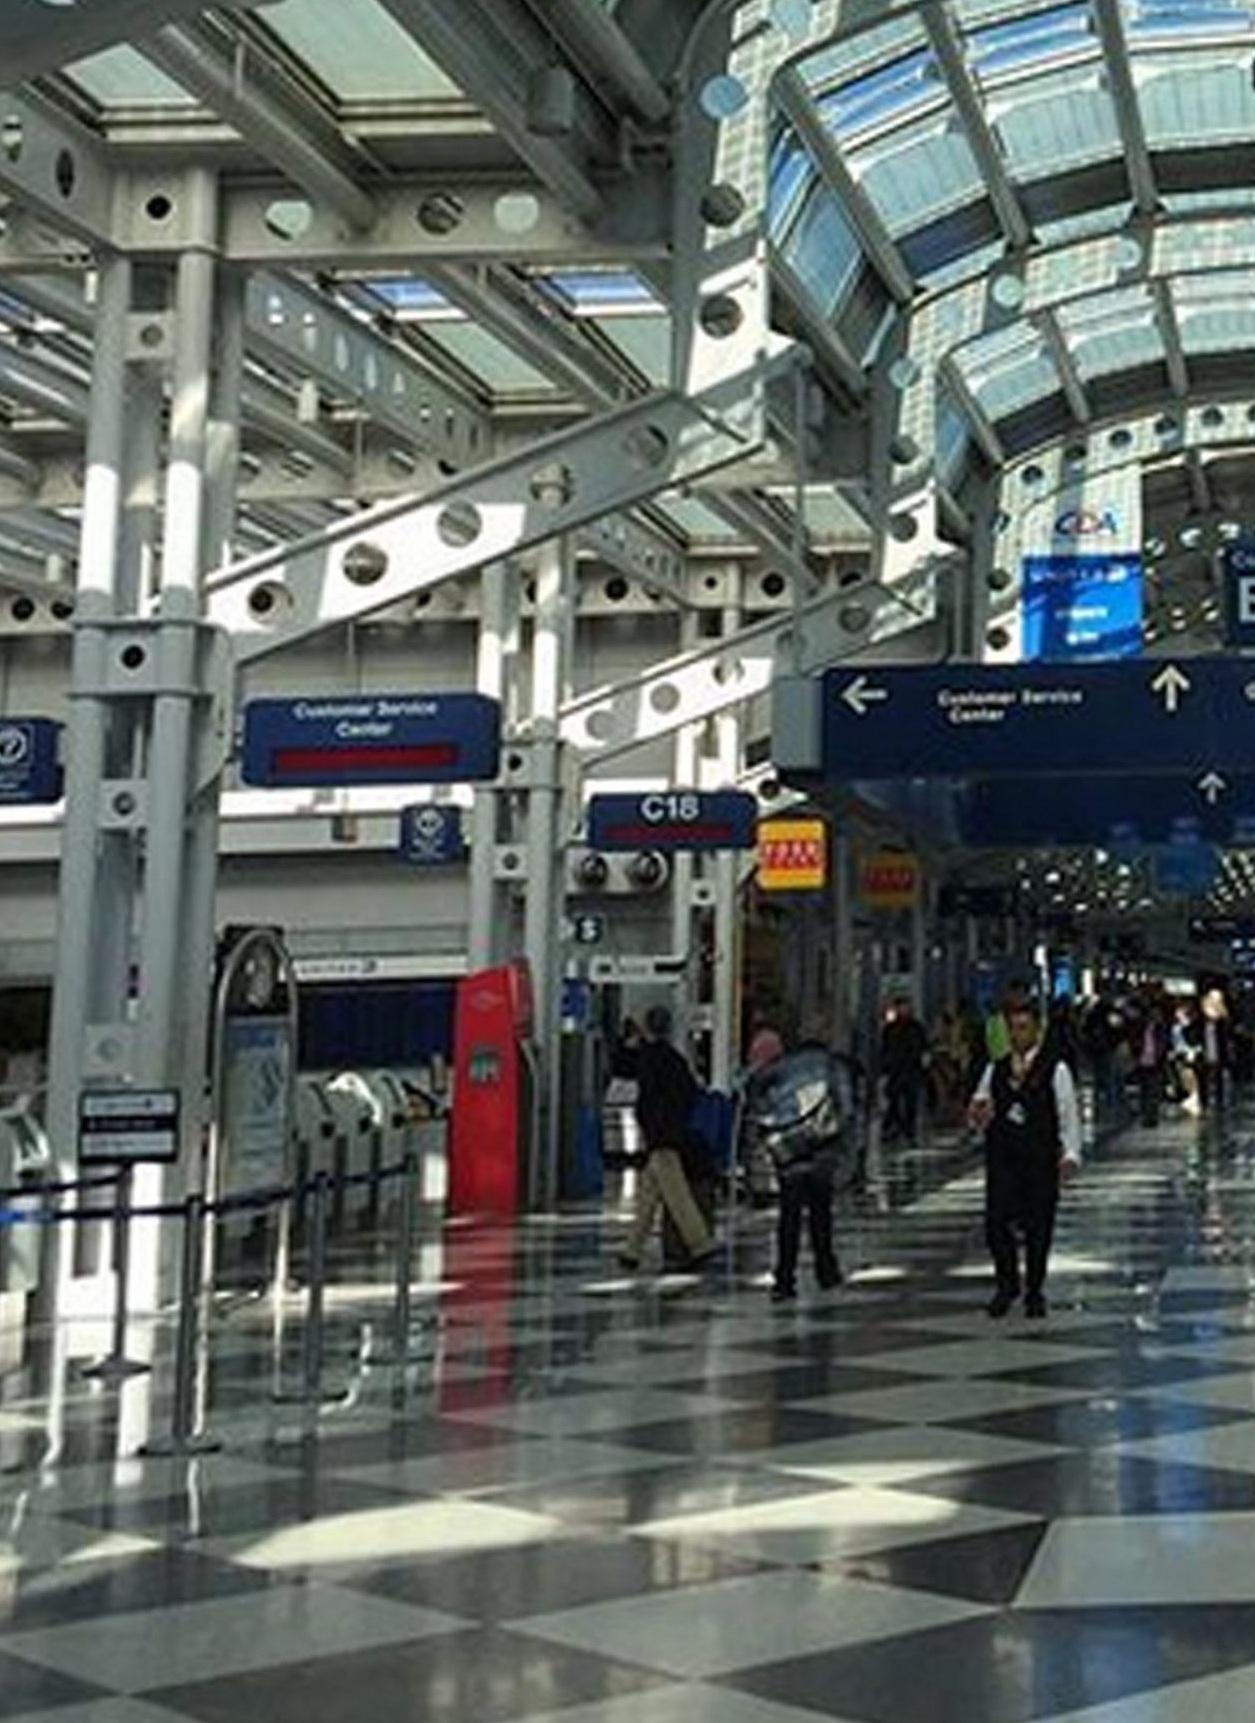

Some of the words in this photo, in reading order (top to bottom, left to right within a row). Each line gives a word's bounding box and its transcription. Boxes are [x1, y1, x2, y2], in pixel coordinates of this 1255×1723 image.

[937, 689, 1017, 707] Customer
[1021, 689, 1083, 705] Service
[293, 703, 373, 720] Customer
[377, 700, 438, 718] Service
[949, 706, 1005, 724] Center
[335, 721, 393, 739] Center
